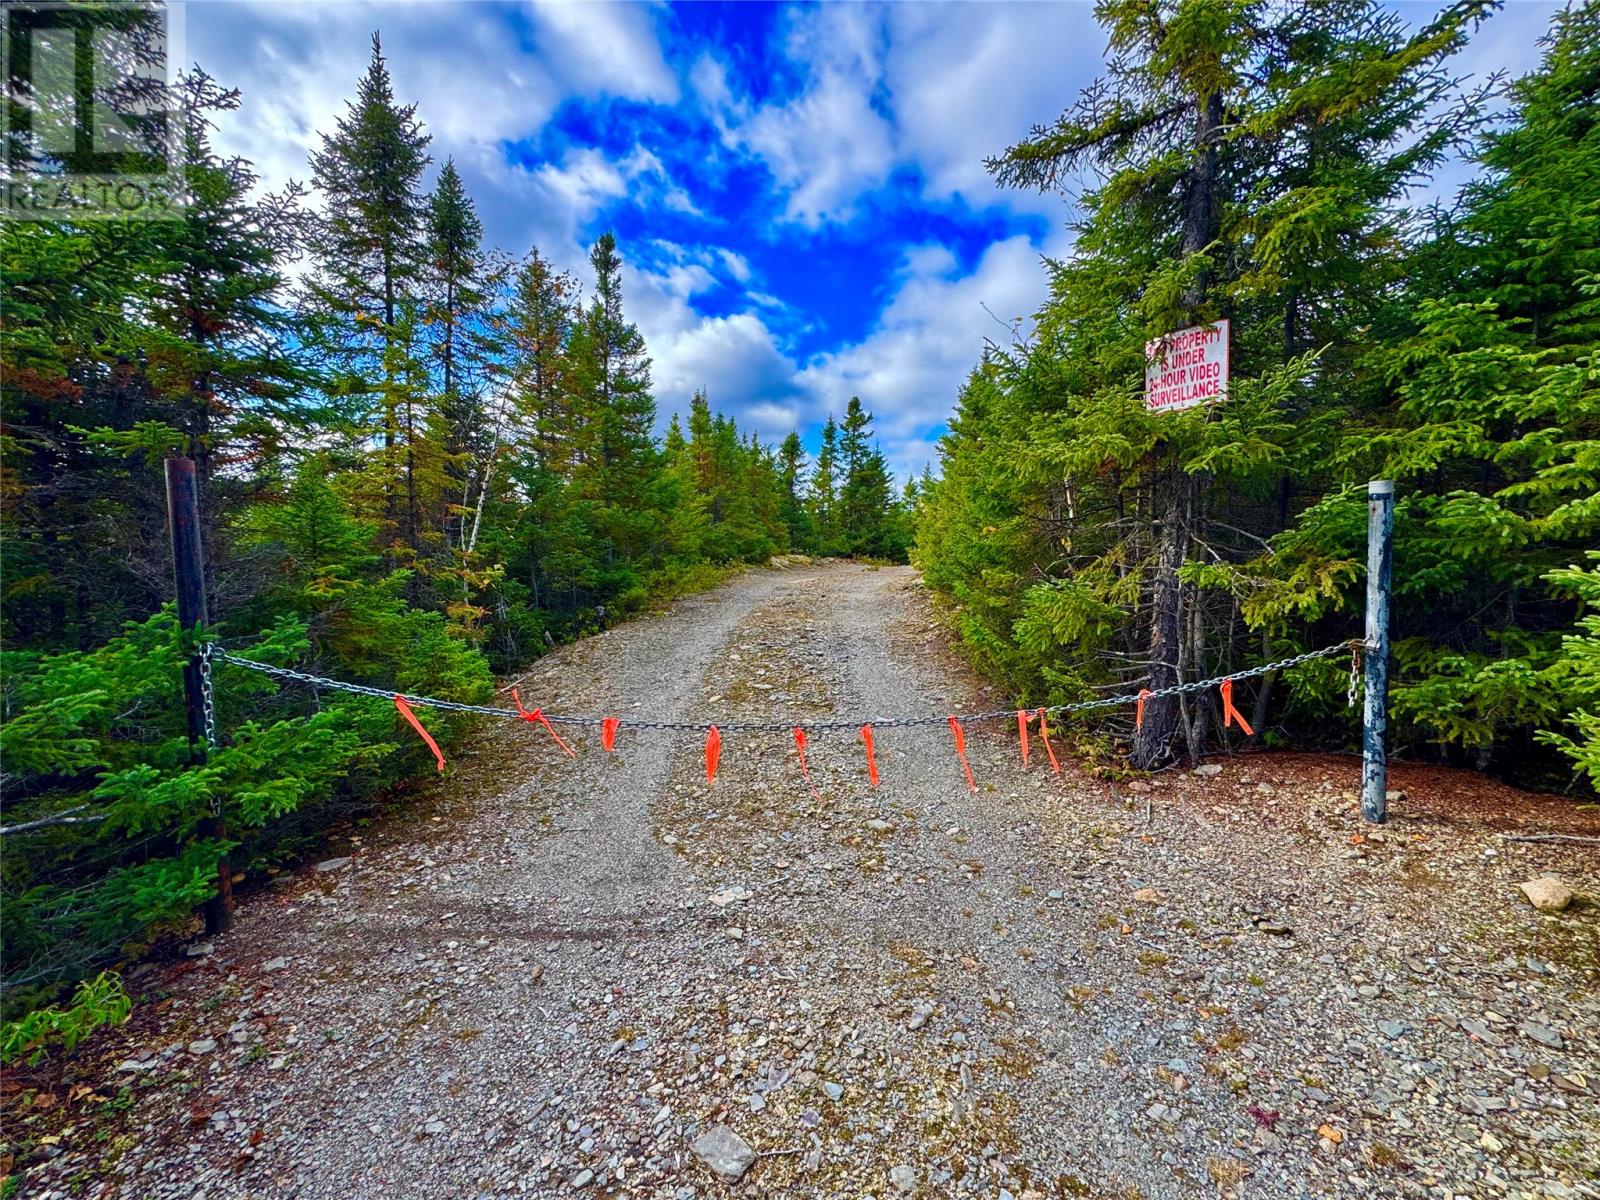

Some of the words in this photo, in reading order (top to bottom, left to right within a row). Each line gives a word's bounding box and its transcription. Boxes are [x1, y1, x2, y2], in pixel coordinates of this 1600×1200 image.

[1171, 327, 1222, 352] PROPERTY
[1161, 358, 1169, 373] IS
[1172, 348, 1205, 369] UNDER
[1189, 362, 1220, 382] VIDEO
[1150, 380, 1220, 408] SURVEILLANCE
